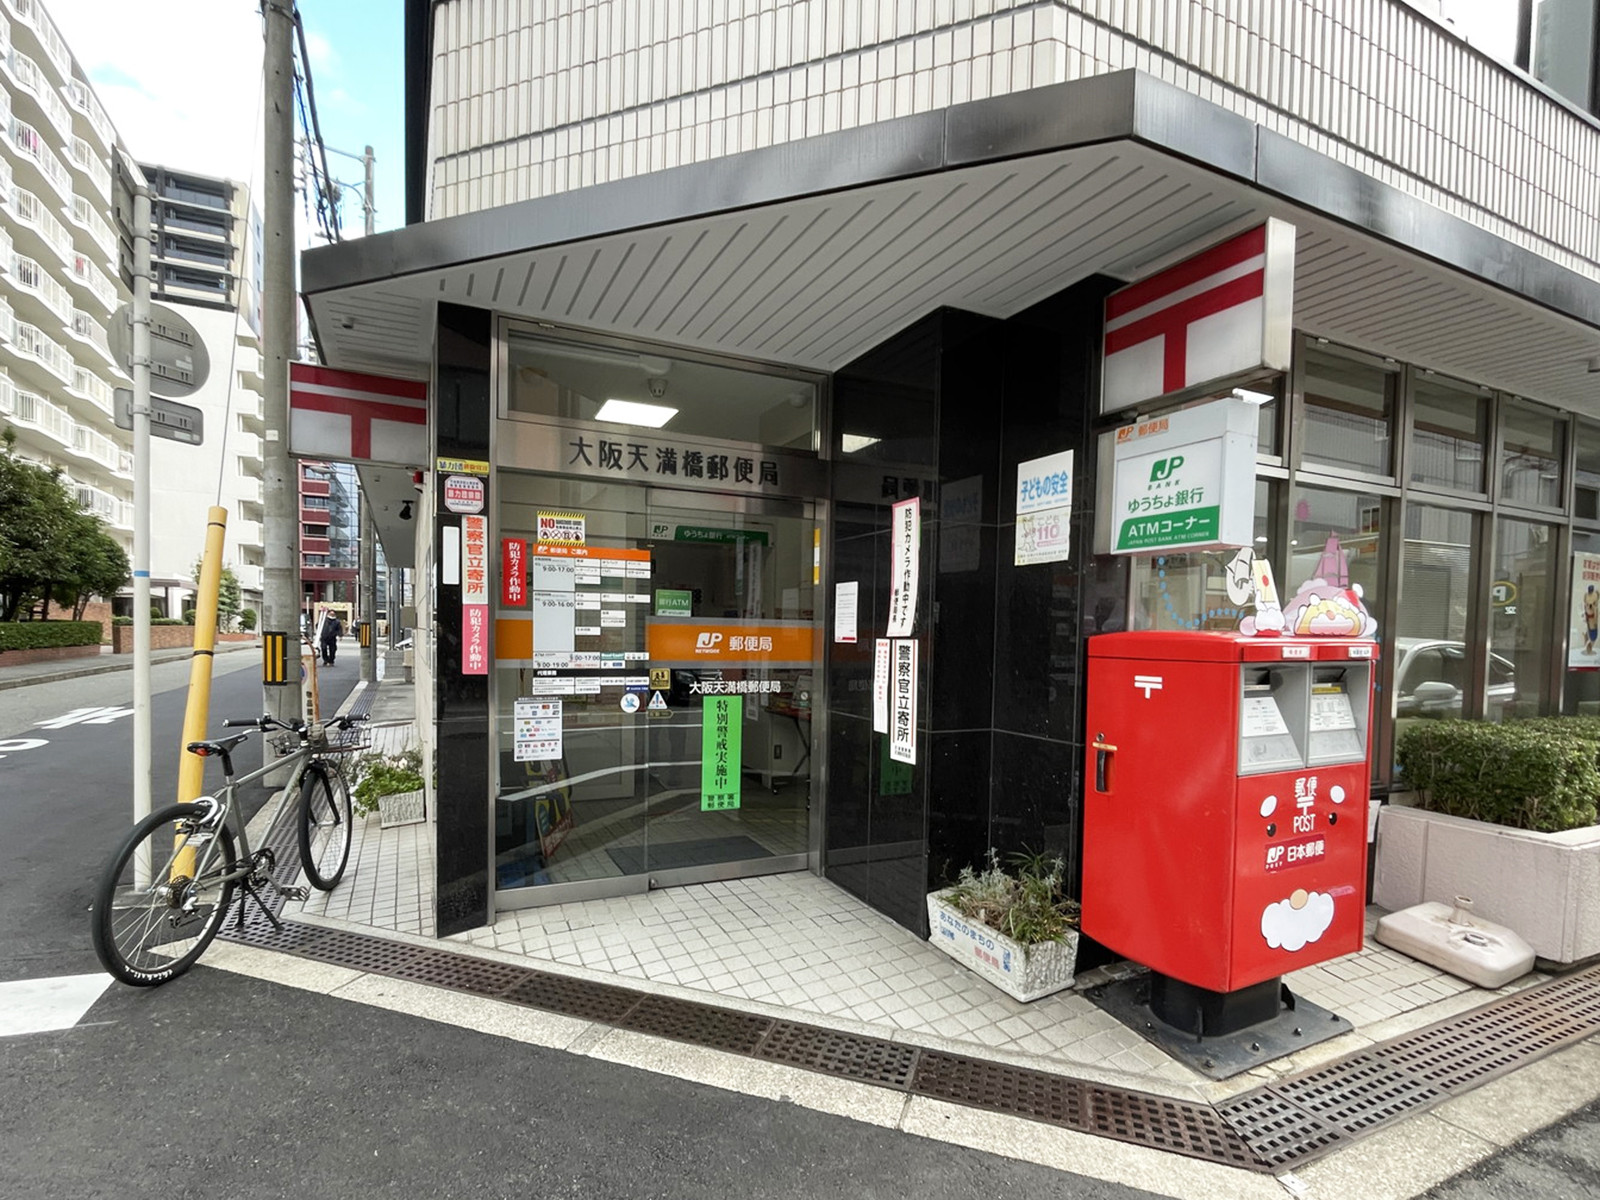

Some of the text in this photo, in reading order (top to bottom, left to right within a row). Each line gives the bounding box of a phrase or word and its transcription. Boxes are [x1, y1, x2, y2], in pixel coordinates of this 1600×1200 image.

[1138, 418, 1169, 437] 郵便局
[569, 436, 779, 486] 大阪天満橋郵便局
[1149, 455, 1184, 482] JP
[1021, 470, 1068, 502] 子どもの安全
[1147, 480, 1181, 491] BANK
[1128, 486, 1204, 514] ゆうちょ銀行
[540, 518, 555, 529] NO
[1036, 524, 1060, 540] 110
[1128, 516, 1210, 537] ATMコーナー
[466, 516, 484, 594] 警察官立寄所
[508, 542, 521, 602] 防犯カメラ作動中
[469, 608, 482, 670] 防犯カメラ作動中
[696, 632, 773, 652] JP 郵便局
[689, 680, 781, 695] 大阪天満橋郵便局
[896, 645, 911, 743] 警察官立寄所
[715, 699, 728, 789] 特別警戒実施中
[1295, 776, 1318, 798] 郵便
[1293, 813, 1316, 834] POST
[1266, 840, 1325, 864] JP 日本郵便
[940, 911, 995, 951] あなたのまちの
